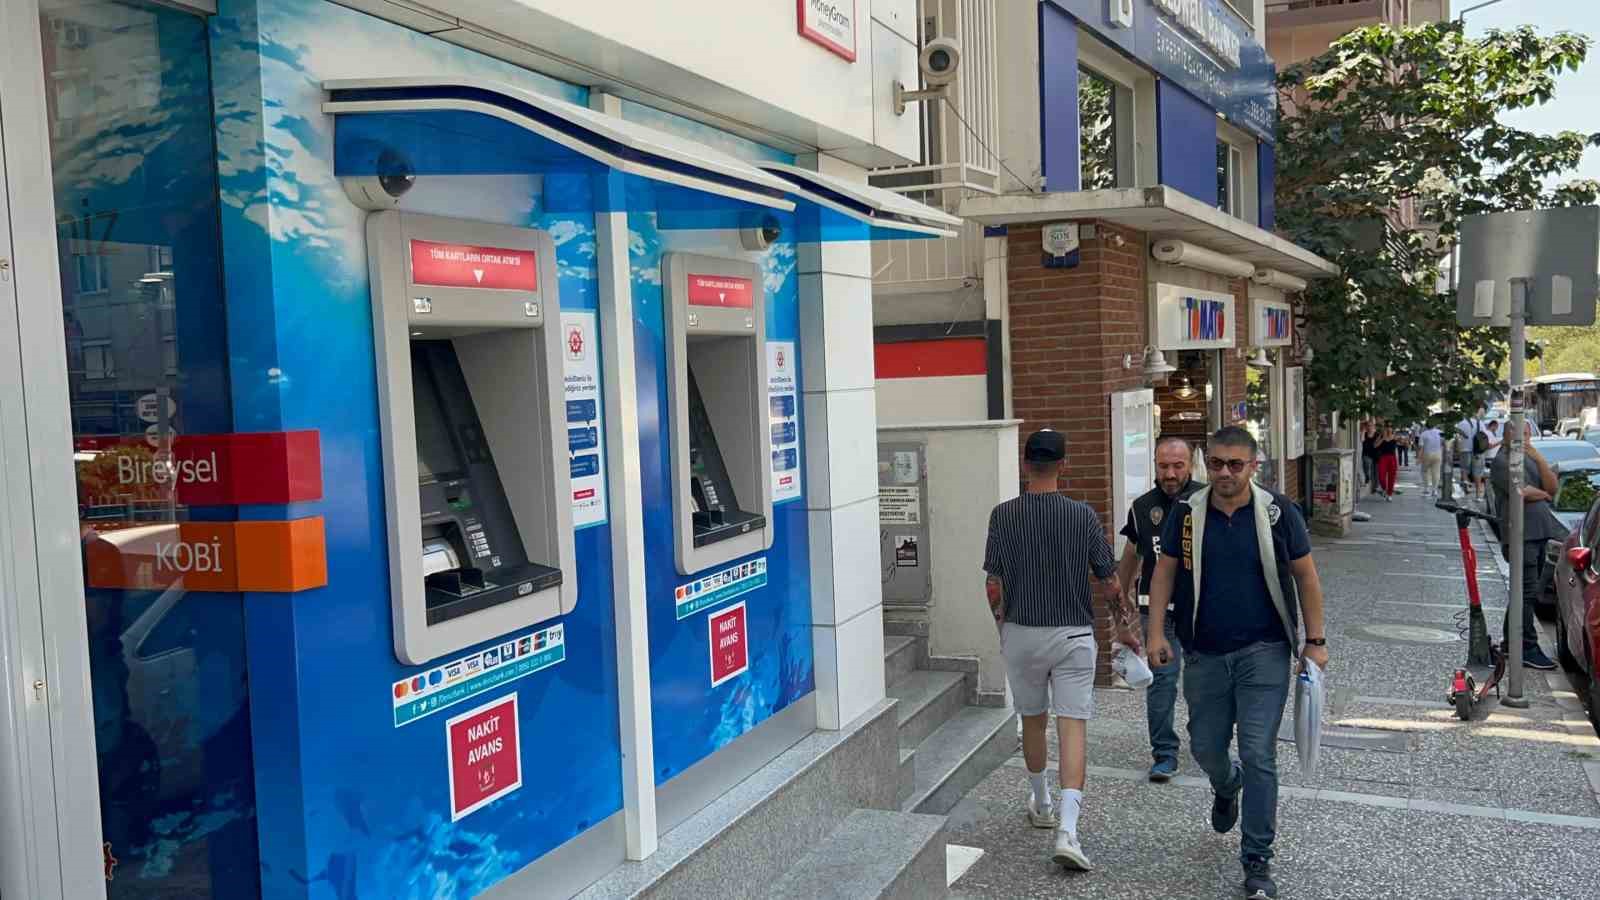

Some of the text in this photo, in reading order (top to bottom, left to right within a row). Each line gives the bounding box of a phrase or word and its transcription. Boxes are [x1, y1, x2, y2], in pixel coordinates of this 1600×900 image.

[117, 451, 218, 490] Bireysel
[155, 535, 223, 572] KOBİ
[719, 615, 737, 633] NAKİT
[719, 632, 739, 650] AVANS
[467, 715, 501, 744] NAKİT
[467, 737, 503, 766] AVANS
